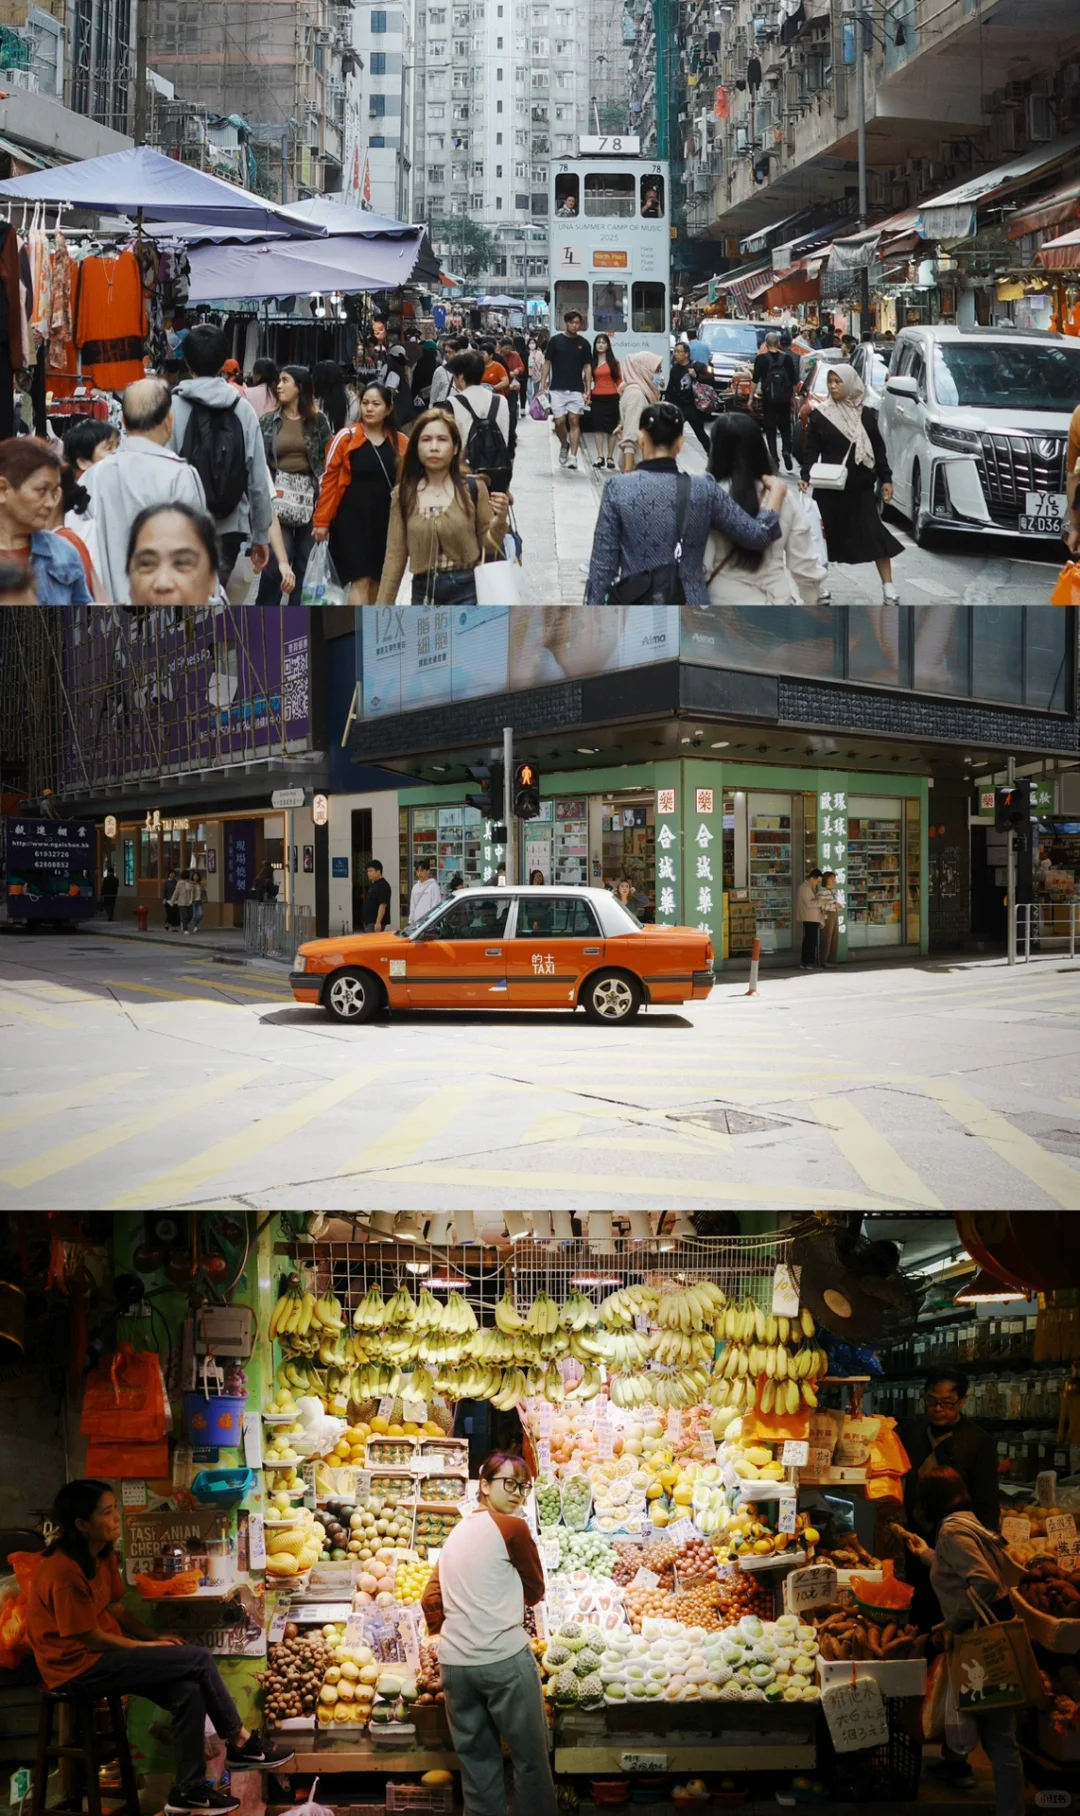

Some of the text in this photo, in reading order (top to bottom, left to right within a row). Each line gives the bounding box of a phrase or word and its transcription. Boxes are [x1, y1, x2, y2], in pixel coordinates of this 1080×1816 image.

[598, 137, 623, 151] 78
[558, 164, 569, 172] 78
[651, 165, 662, 173] 78
[1038, 493, 1056, 506] YG
[1035, 504, 1060, 517] 715
[173, 818, 189, 830] HING
[34, 850, 70, 858] 61932726
[657, 823, 677, 927] 合誠藥
[531, 953, 554, 964] 的士
[532, 963, 555, 975] TAXI
[129, 1525, 201, 1542] TASANIAN
[130, 1541, 188, 1557] CHERS
